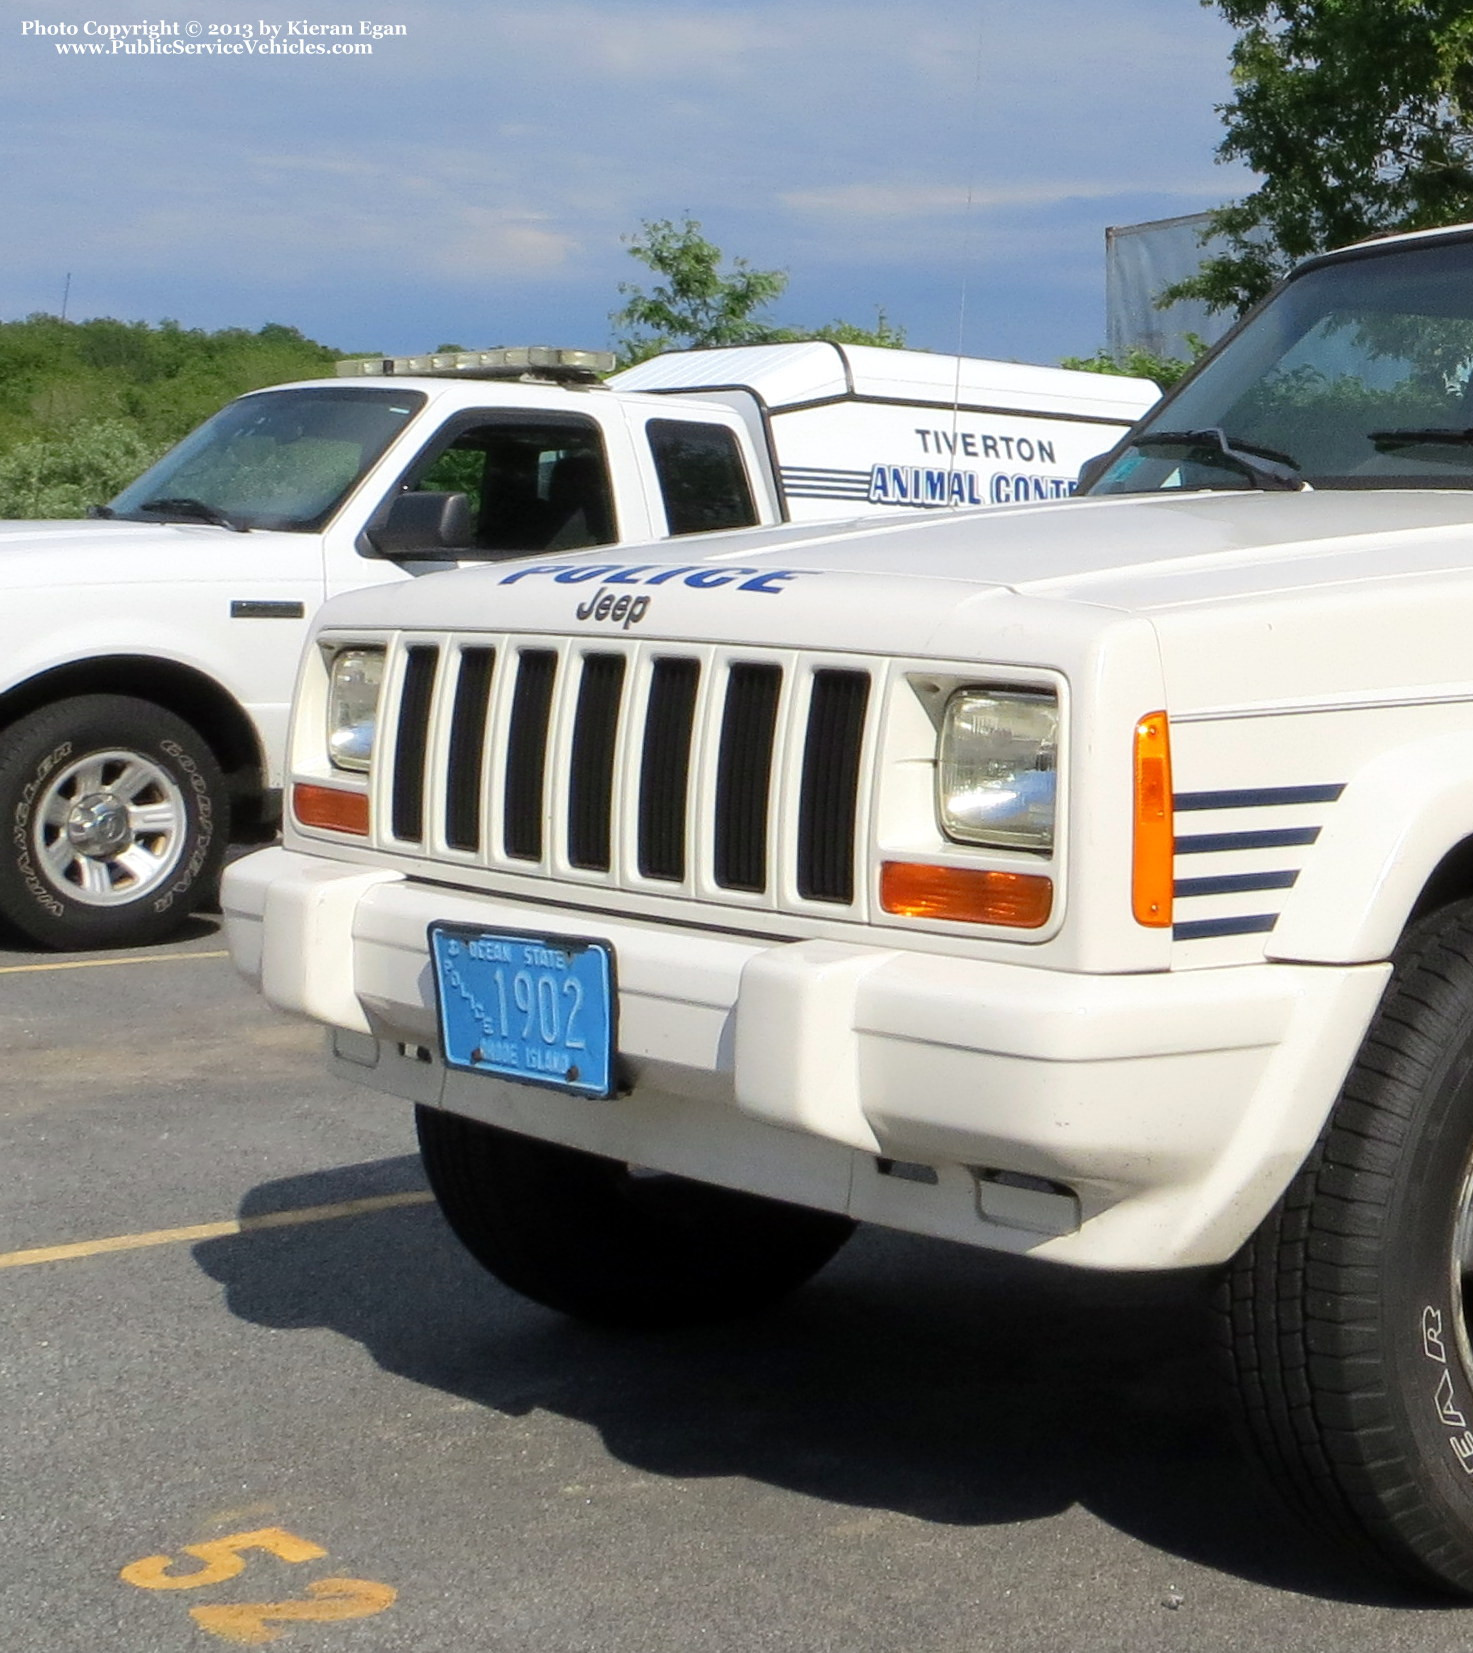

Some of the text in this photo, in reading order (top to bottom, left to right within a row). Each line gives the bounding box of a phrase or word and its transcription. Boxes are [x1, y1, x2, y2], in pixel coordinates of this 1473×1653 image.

[914, 428, 1057, 463] TIVERTON
[871, 463, 983, 507] ANIMAL
[497, 564, 826, 595] POLICE
[576, 587, 651, 631] Jeep
[468, 939, 569, 971] OCEAN STATE
[493, 966, 587, 1050] 1902
